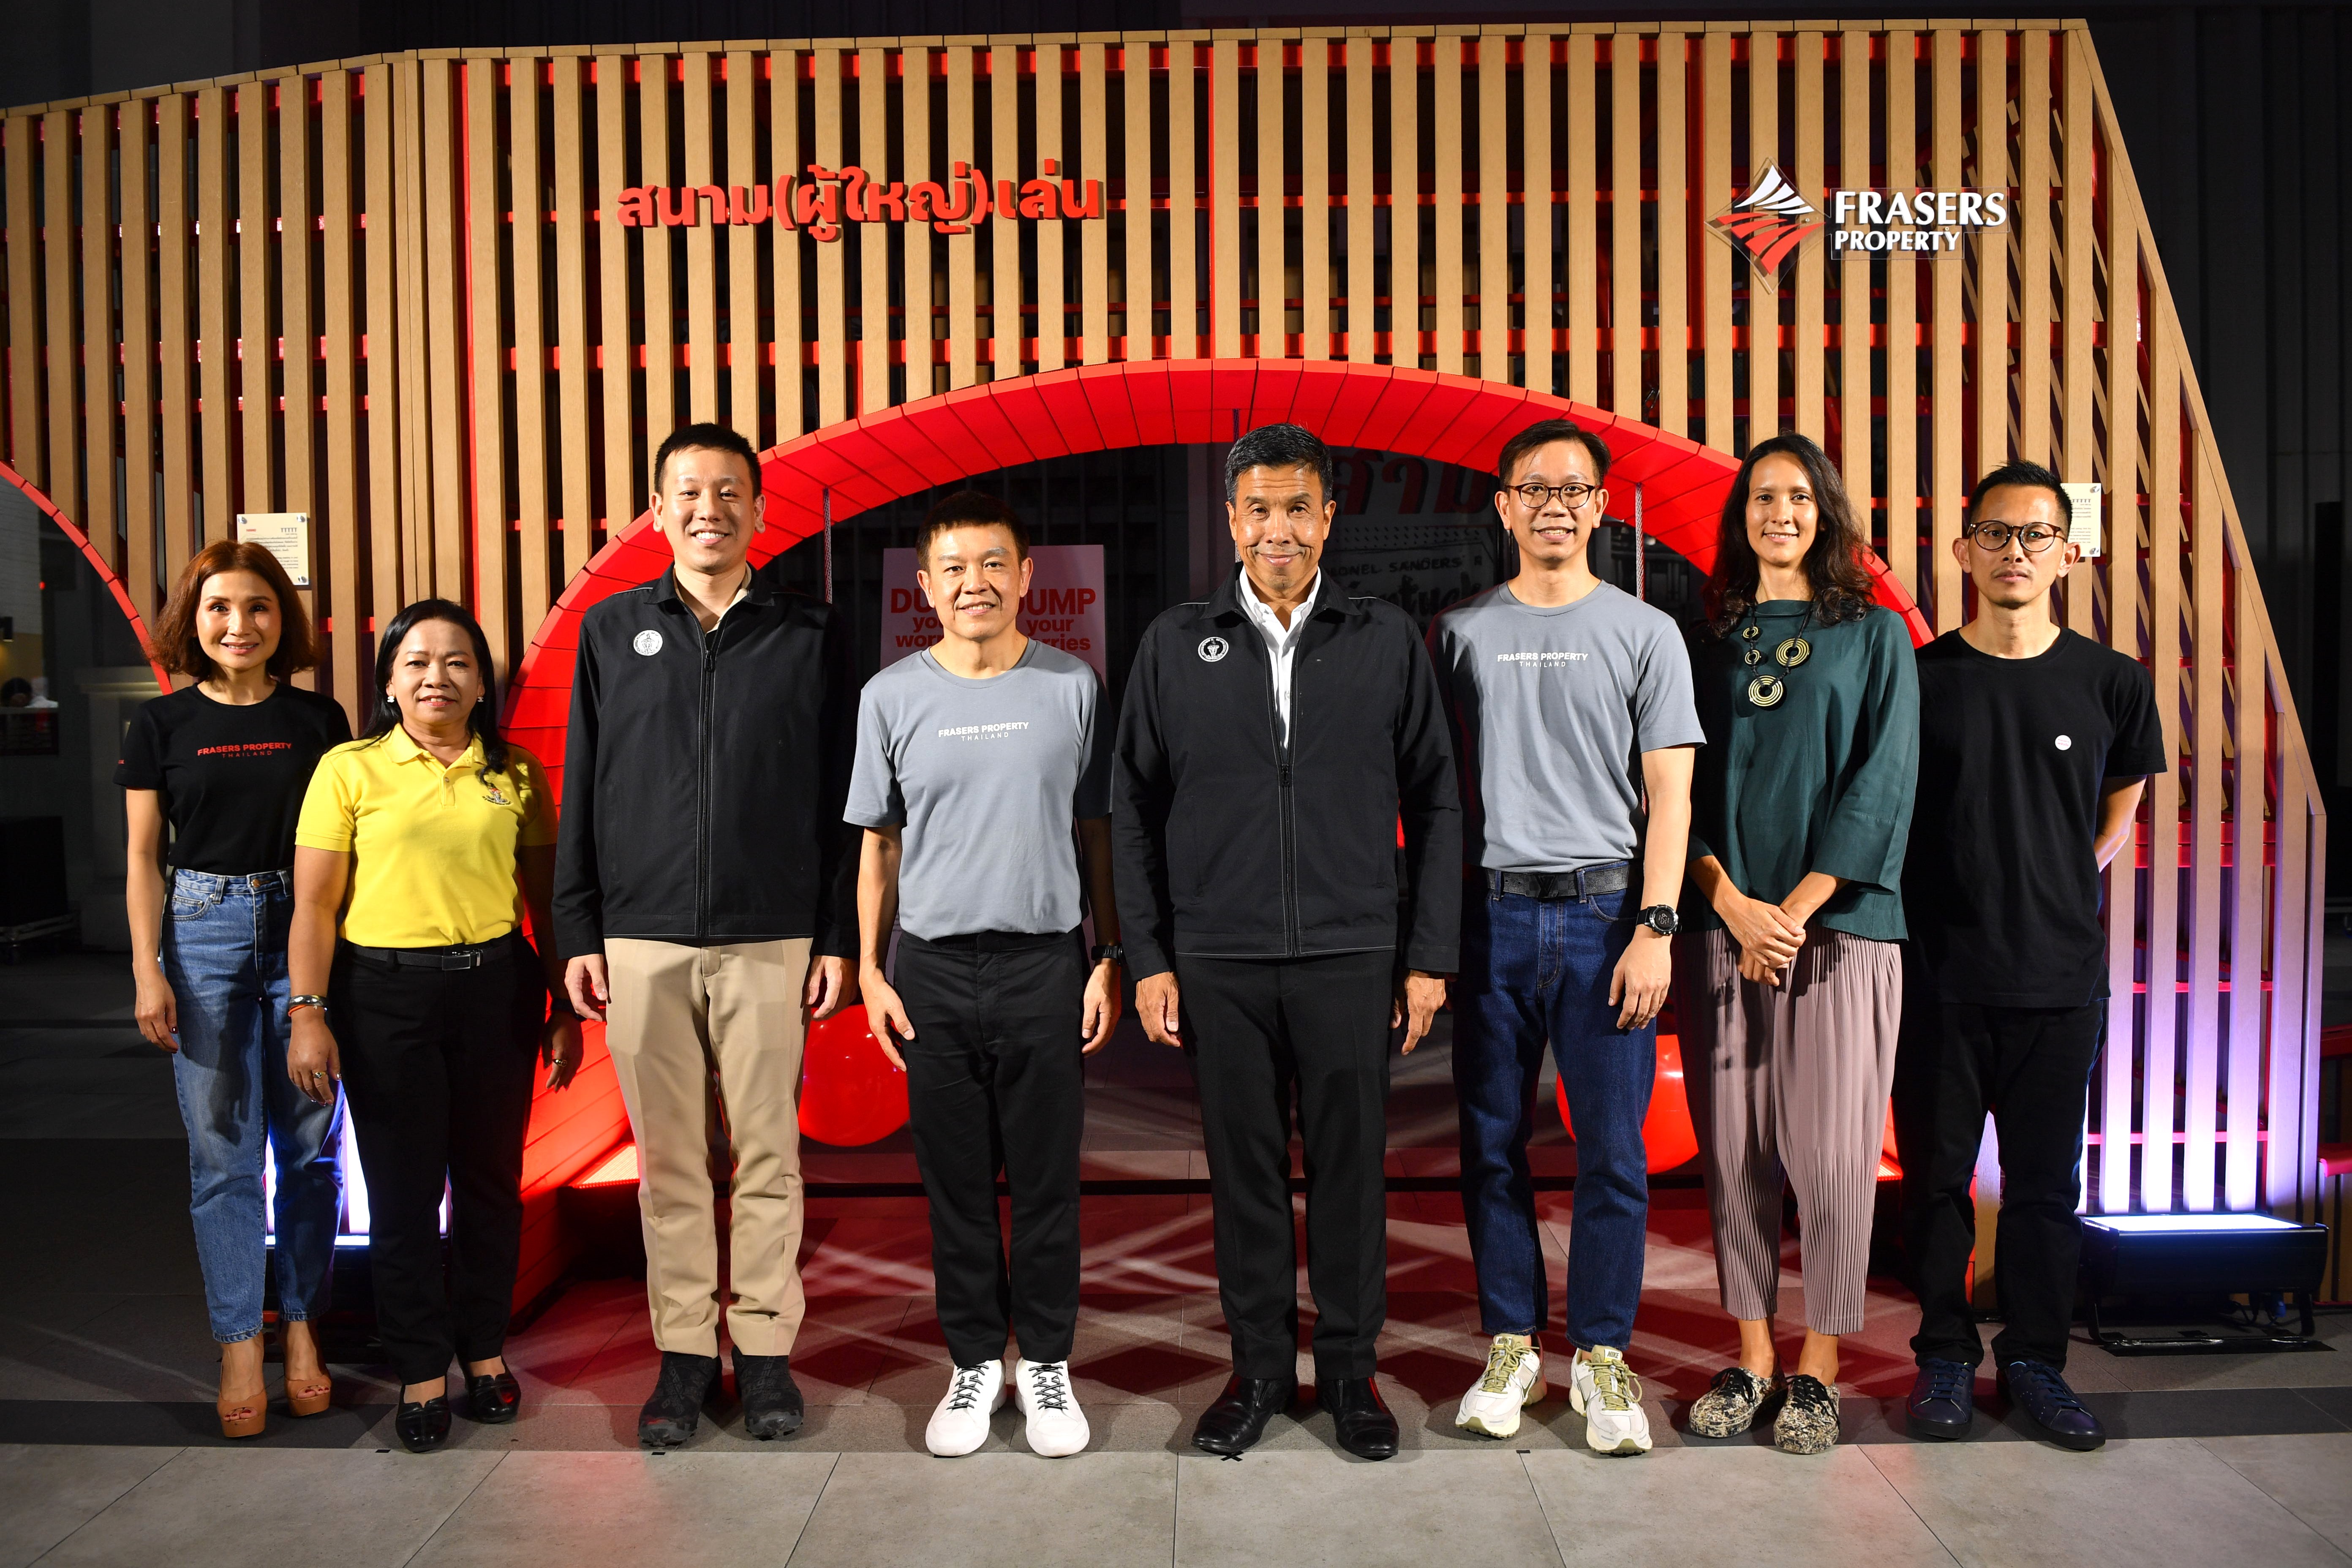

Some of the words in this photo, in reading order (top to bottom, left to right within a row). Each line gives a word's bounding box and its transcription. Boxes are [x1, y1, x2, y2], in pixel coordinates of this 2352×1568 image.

[617, 158, 1099, 242] สนาม(ผู้ใหญ่)เล่น
[1835, 191, 2006, 226] FRASERS
[1835, 231, 1960, 251] PROPERTY
[891, 588, 933, 613] DU
[912, 617, 944, 633] yo
[1026, 619, 1074, 637] your
[1497, 653, 1538, 662] FRASERS
[1541, 652, 1588, 661] PROPERTY
[938, 726, 979, 738] FRASERS
[981, 722, 1029, 733] PROPERTY
[961, 732, 1009, 741] THAILAND
[197, 744, 240, 756] FRASERS
[243, 742, 291, 750] PROPERTY
[222, 750, 272, 758] THAILAND
[1607, 1351, 1619, 1359] NIKE
